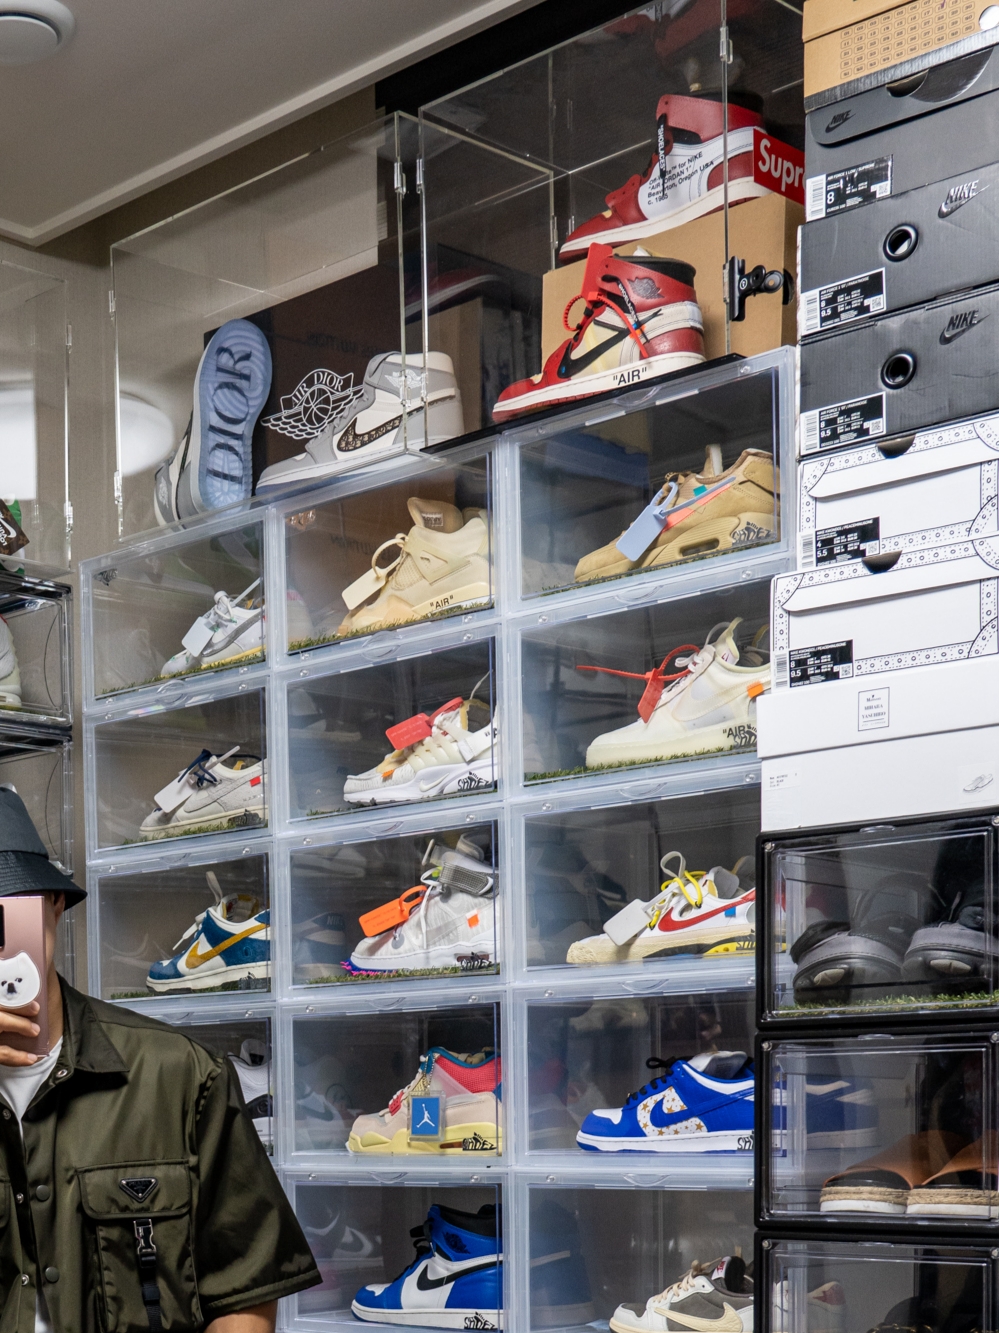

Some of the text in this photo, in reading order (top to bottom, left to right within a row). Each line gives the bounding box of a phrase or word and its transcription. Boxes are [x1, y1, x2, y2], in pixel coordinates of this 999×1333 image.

[830, 110, 852, 125] NIKE
[678, 160, 687, 169] for
[688, 151, 703, 164] NIKE
[758, 138, 805, 192] Supr
[678, 169, 698, 185] Oregon
[699, 161, 714, 172] USA
[827, 191, 835, 205] 8
[945, 179, 980, 205] NIKE
[821, 308, 832, 318] 9.5
[946, 309, 980, 333] NIKE
[613, 366, 647, 387] "AIR"
[291, 369, 344, 407] AIR DIOR
[208, 346, 251, 484] DIOR
[820, 429, 832, 438] 9.5
[817, 540, 822, 548] 4
[817, 549, 828, 558] 5.5
[430, 594, 454, 611] "AIR"
[790, 669, 802, 678] 9.5
